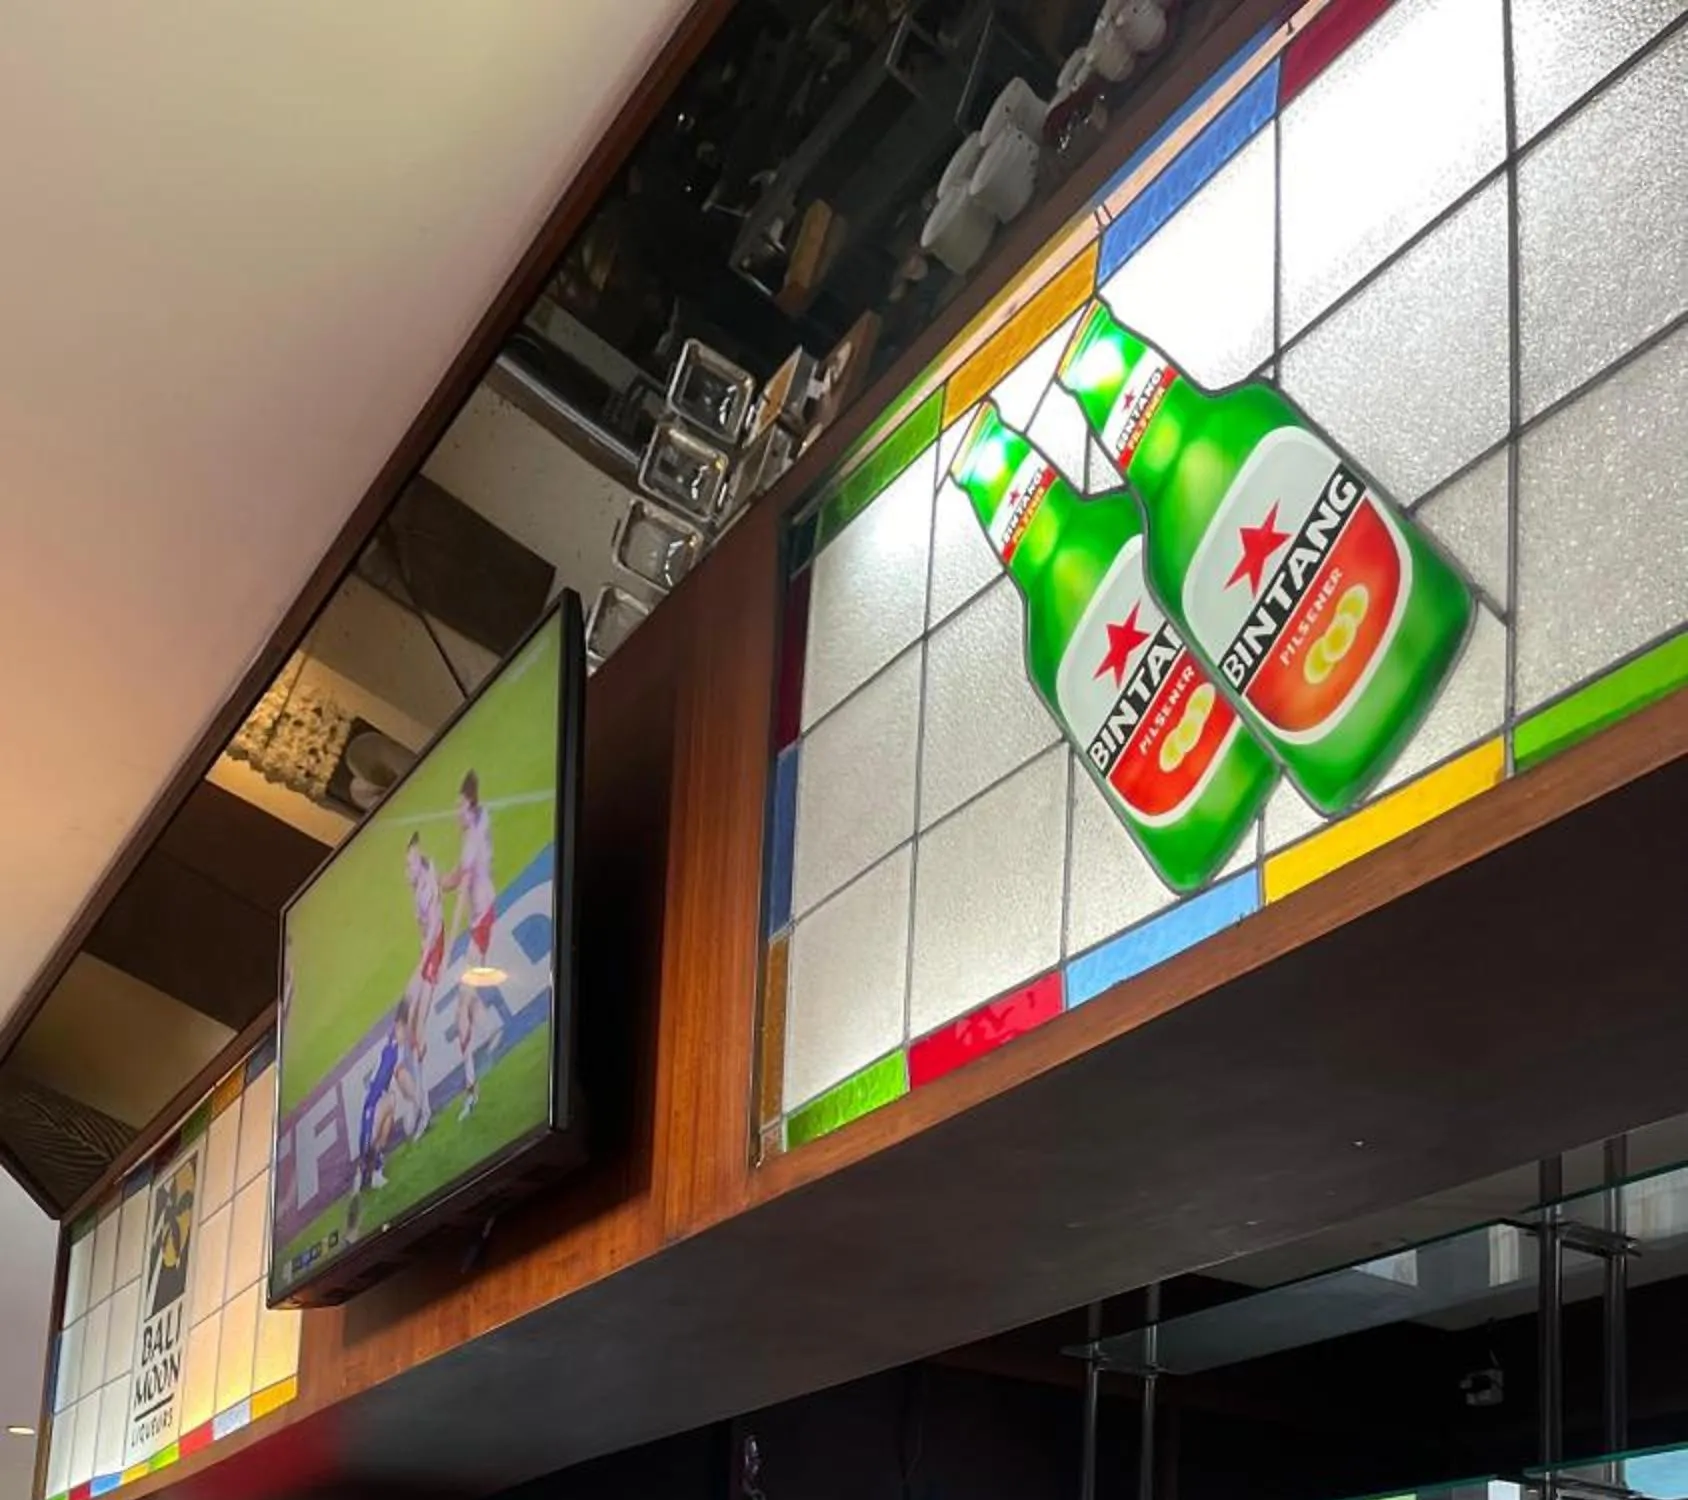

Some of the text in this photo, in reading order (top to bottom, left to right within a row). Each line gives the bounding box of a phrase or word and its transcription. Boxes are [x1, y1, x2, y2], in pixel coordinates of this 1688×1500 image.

[1221, 472, 1358, 687] BINTANG
[1279, 566, 1343, 667] PILSENER
[1089, 623, 1184, 771] BINTA
[1138, 664, 1196, 756] PILSENER
[133, 1348, 181, 1412] MOON
[141, 1301, 183, 1367] BALI
